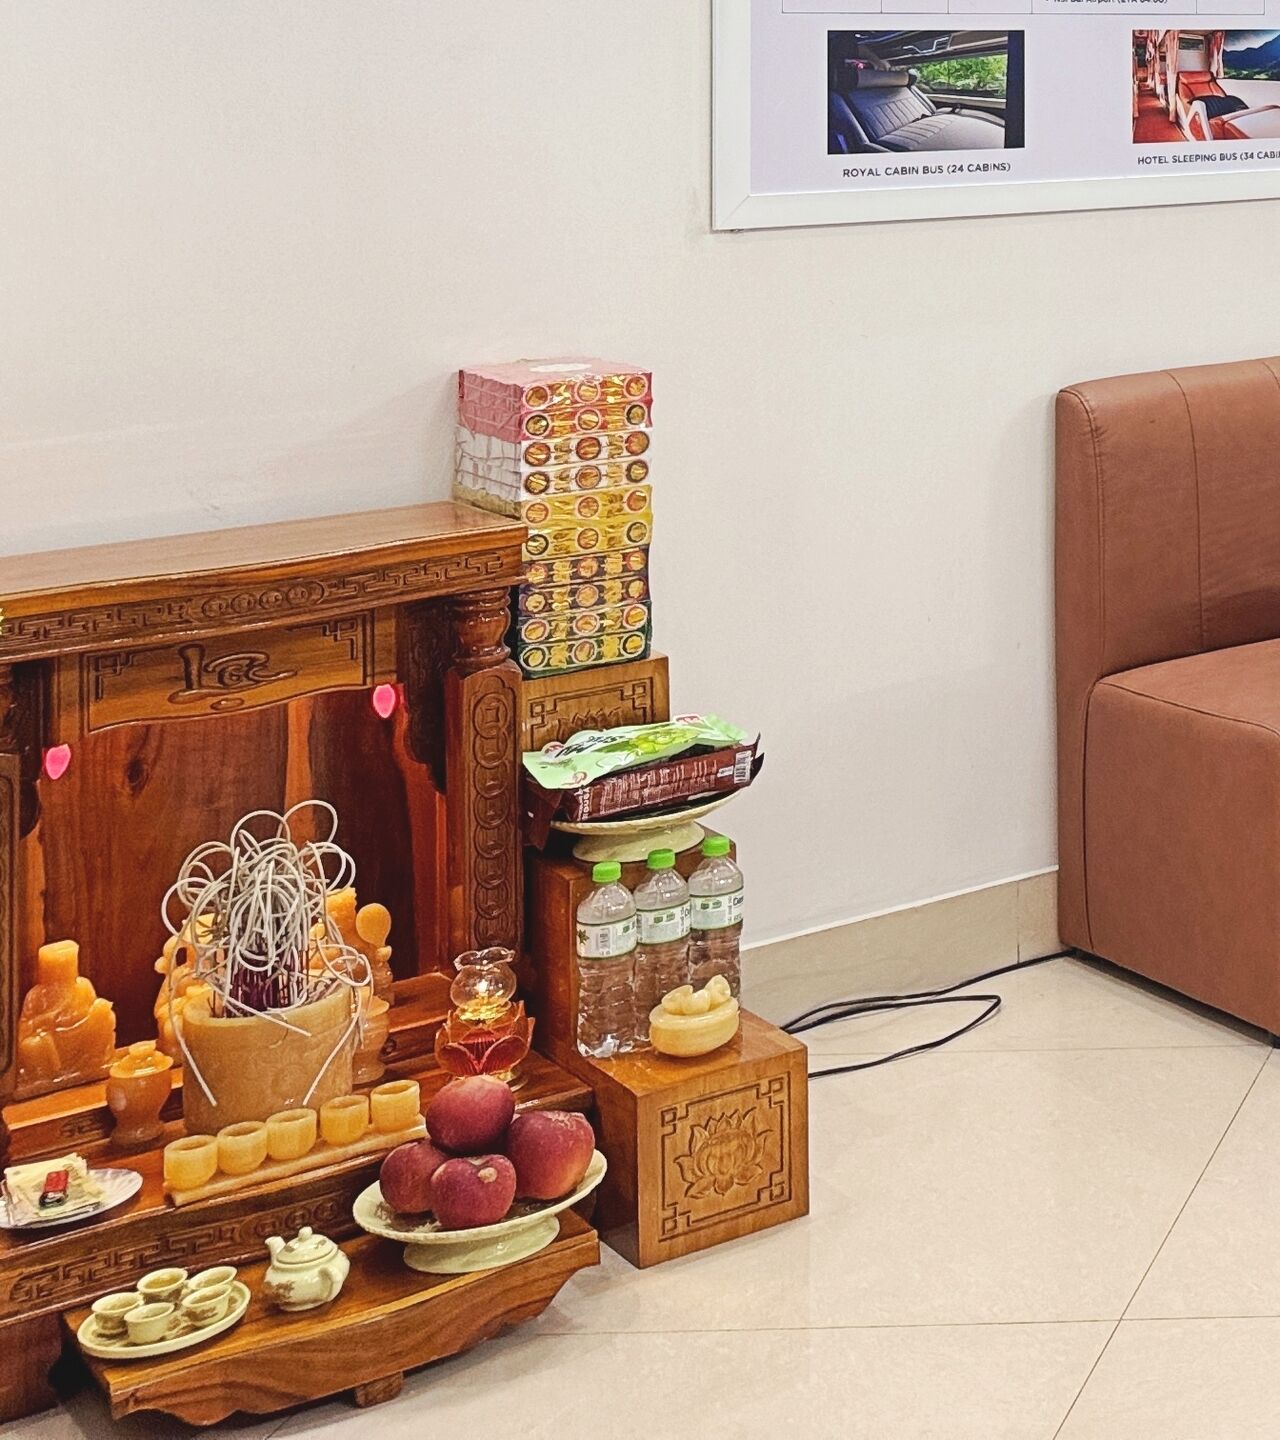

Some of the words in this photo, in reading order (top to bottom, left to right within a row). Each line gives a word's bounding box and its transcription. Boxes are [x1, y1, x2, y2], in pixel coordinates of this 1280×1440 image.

[1137, 155, 1169, 165] HOTEL
[1171, 152, 1217, 164] SLEEPING
[1219, 151, 1238, 162] BUS
[1239, 151, 1255, 161] (34
[842, 167, 881, 178] ROYAL
[884, 165, 919, 176] CABIN
[922, 164, 944, 175] BUS
[946, 163, 965, 175] (24
[966, 162, 1011, 173] CABINS)
